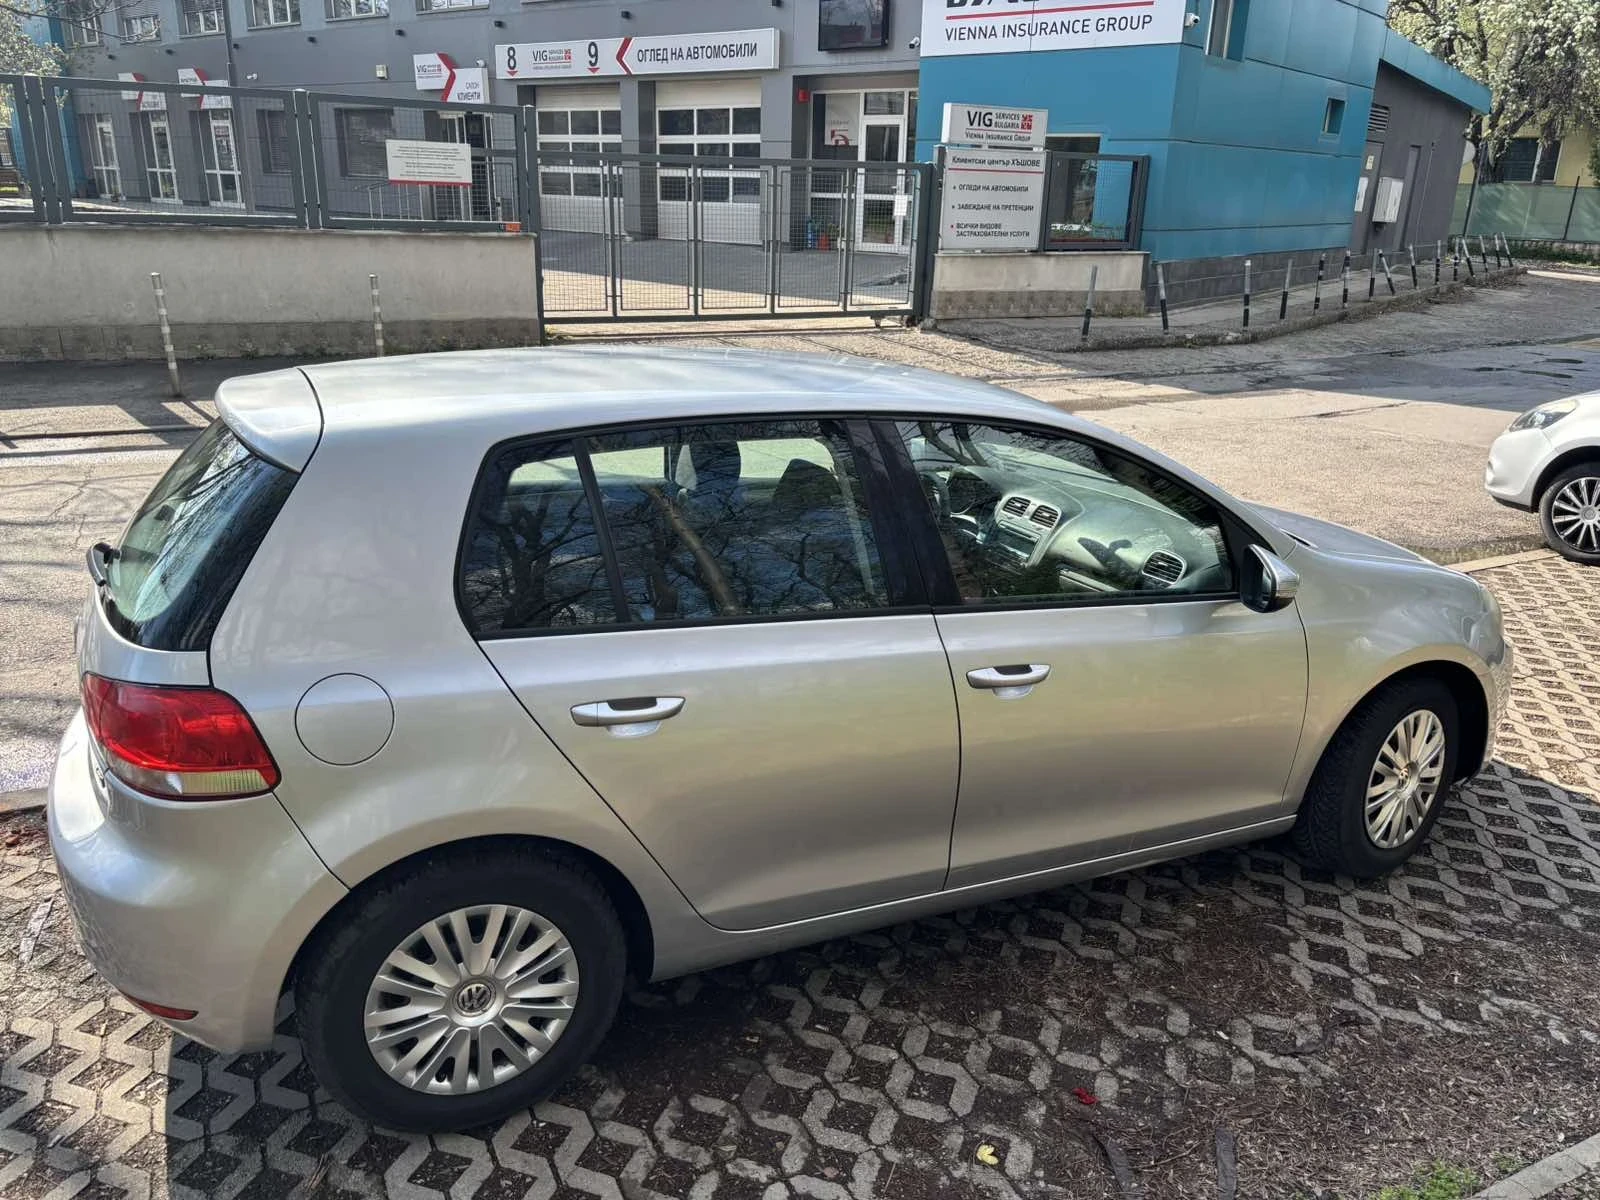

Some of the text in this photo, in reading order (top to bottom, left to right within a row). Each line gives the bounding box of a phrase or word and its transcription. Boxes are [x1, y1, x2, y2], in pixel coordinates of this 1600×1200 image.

[945, 14, 1153, 41] VIENNA INSURANCE GROUP
[507, 46, 517, 71] 8
[532, 49, 548, 62] VIG
[588, 41, 599, 67] 9
[637, 42, 758, 64] ОГЛЕД НА АВТОМОБИЛИ
[967, 110, 993, 127] VIG
[994, 121, 1019, 129] BULGARIA
[995, 112, 1020, 120] SERVICES
